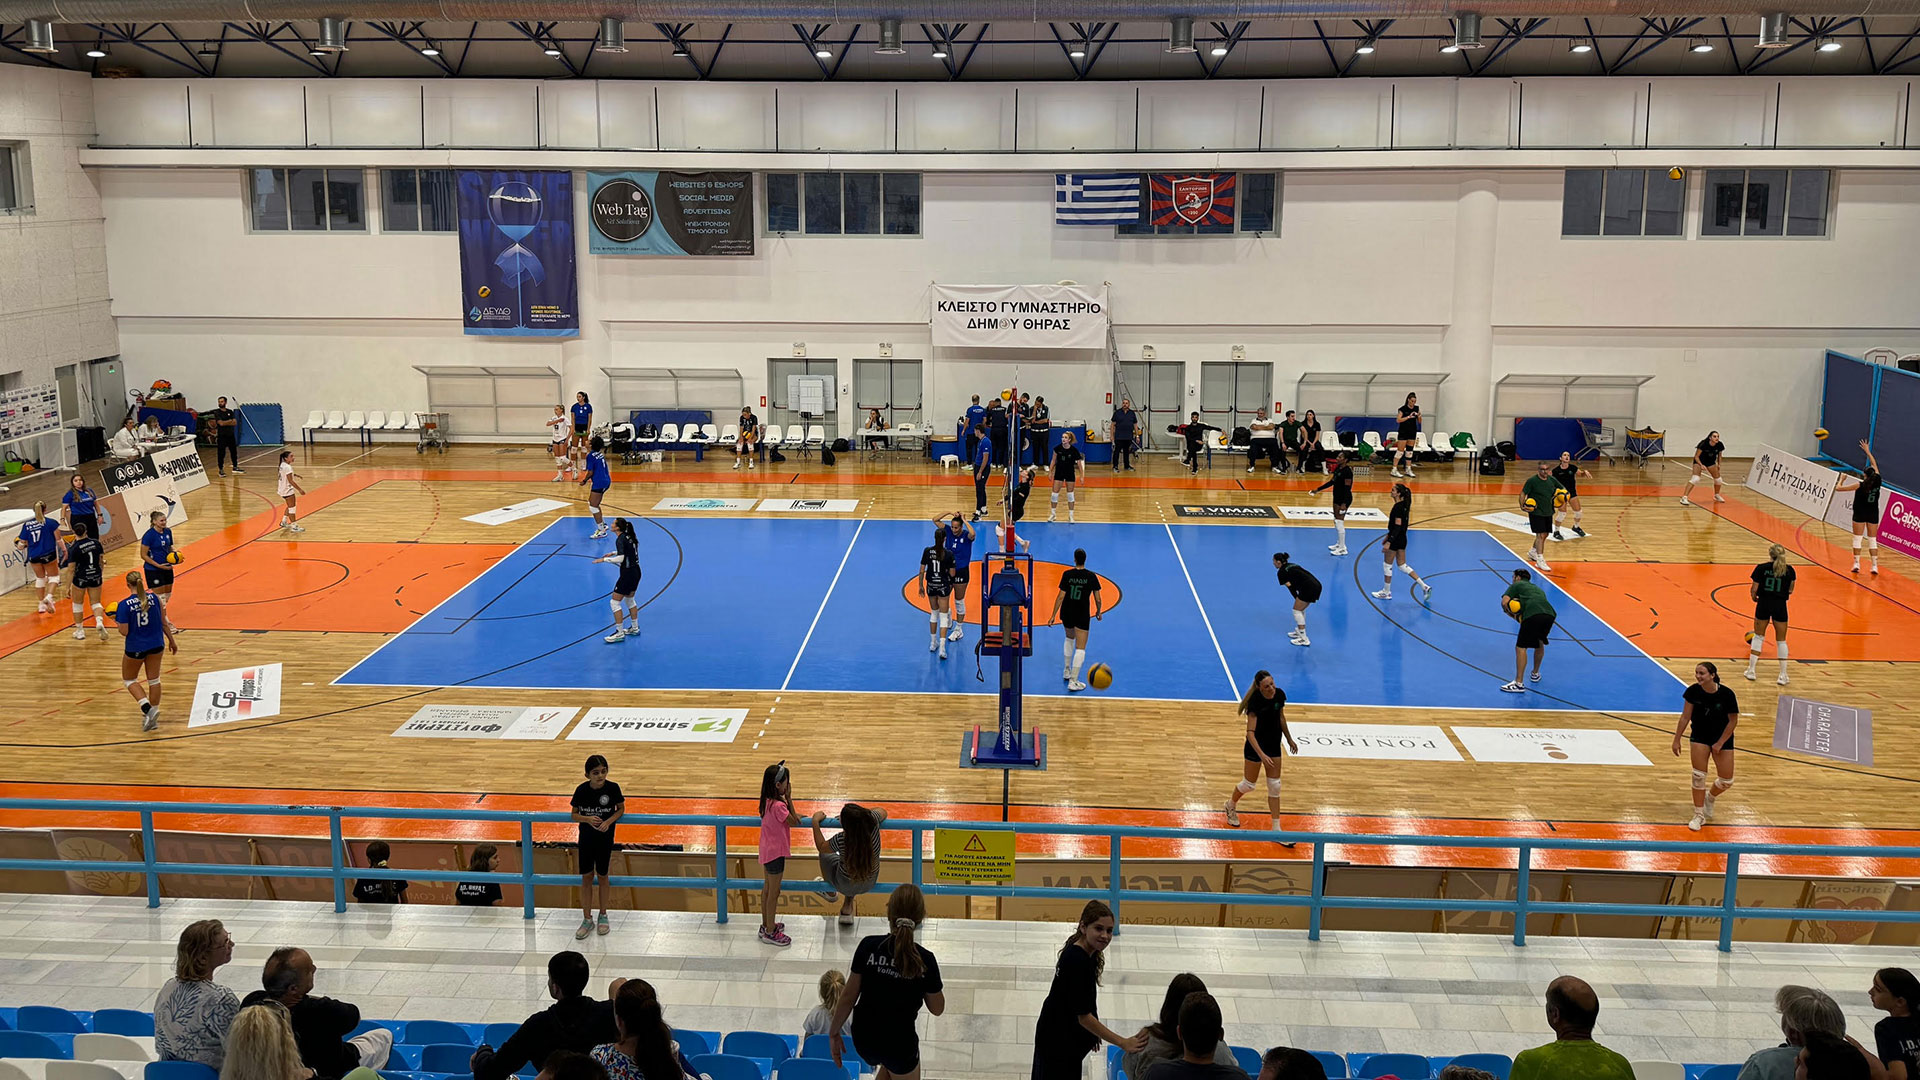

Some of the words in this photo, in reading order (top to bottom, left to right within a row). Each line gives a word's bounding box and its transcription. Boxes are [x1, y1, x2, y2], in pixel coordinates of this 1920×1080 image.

[669, 181, 706, 189] WEBSITES
[714, 181, 744, 189] ESHOPS
[679, 194, 708, 202] SOCIAL
[596, 202, 623, 216] Web
[624, 203, 649, 219] Tag
[937, 300, 998, 314] ΚΛΕΙΣΤΟ
[1001, 301, 1102, 315] ΓΥΜΝΑΣΤΗΡΙΟ
[1023, 318, 1072, 331] ΘΗΡΑΣ
[115, 461, 145, 481] AGL
[171, 452, 202, 476] PRINCE
[1770, 461, 1828, 500] HATZIDAKIS
[1768, 478, 1824, 508] SANTORINI
[31, 529, 42, 543] 17
[88, 551, 94, 564] 1
[932, 559, 941, 573] 11
[1764, 577, 1782, 592] 91
[1069, 585, 1083, 600] 16
[136, 611, 149, 628] 13
[405, 722, 502, 733] ΦΟΥΣΤΕΡΗΣ
[589, 721, 690, 730] sinolakis
[1815, 705, 1832, 753] CHARACTER
[1296, 735, 1437, 749] PONIROS
[1503, 732, 1577, 740] SEASIDE
